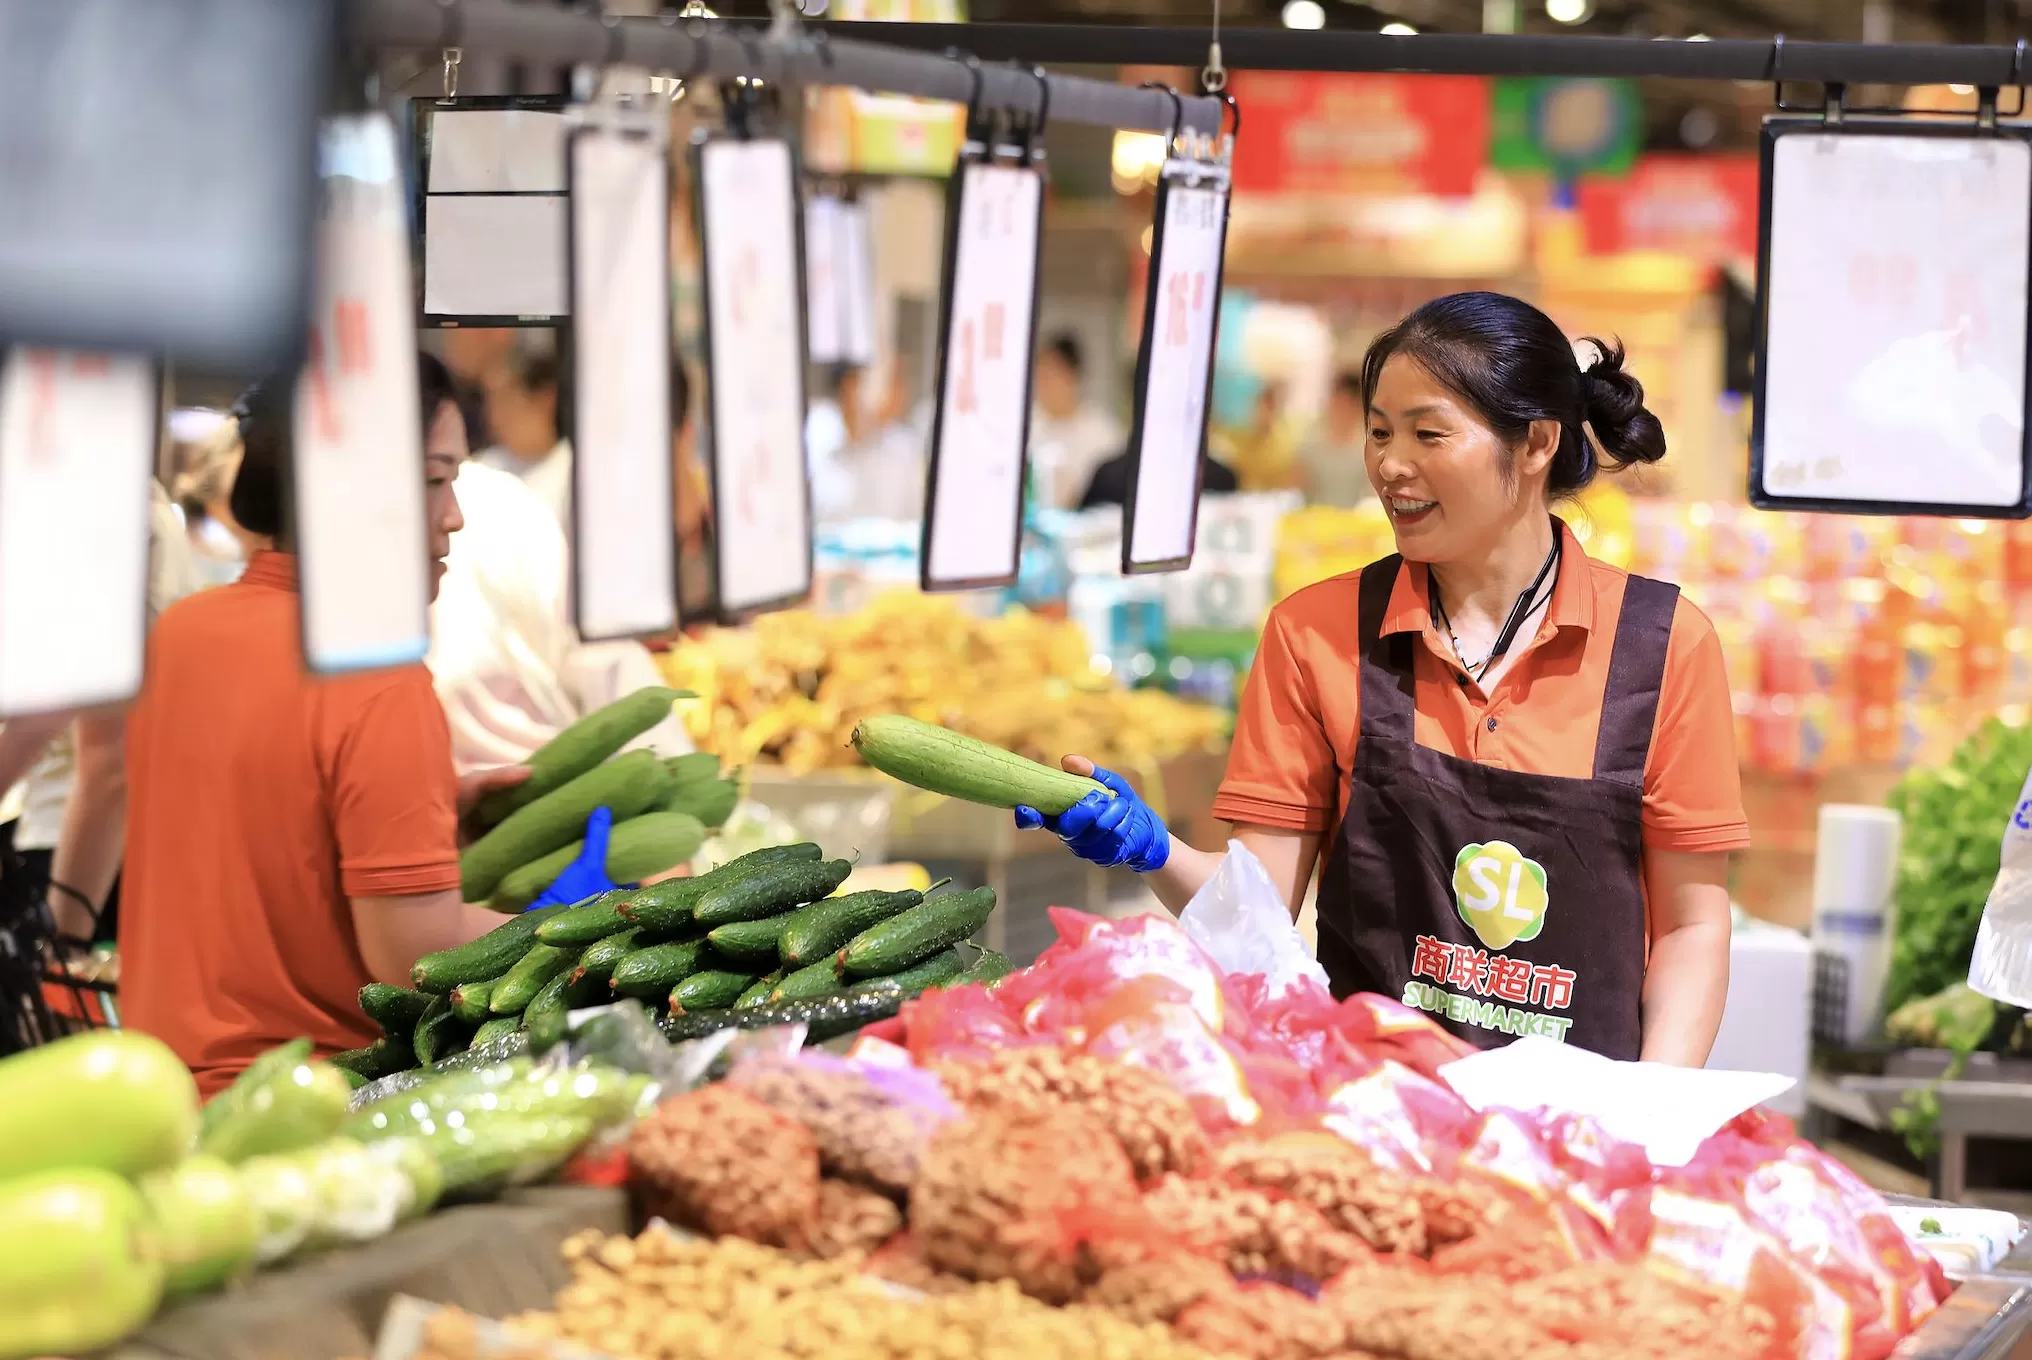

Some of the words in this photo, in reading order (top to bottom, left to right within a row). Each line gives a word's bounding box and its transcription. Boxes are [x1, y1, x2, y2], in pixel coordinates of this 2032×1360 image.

[1465, 856, 1533, 921] SL
[1411, 935, 1577, 1009] 商联超市
[1401, 981, 1573, 1043] SUPERMARKET
